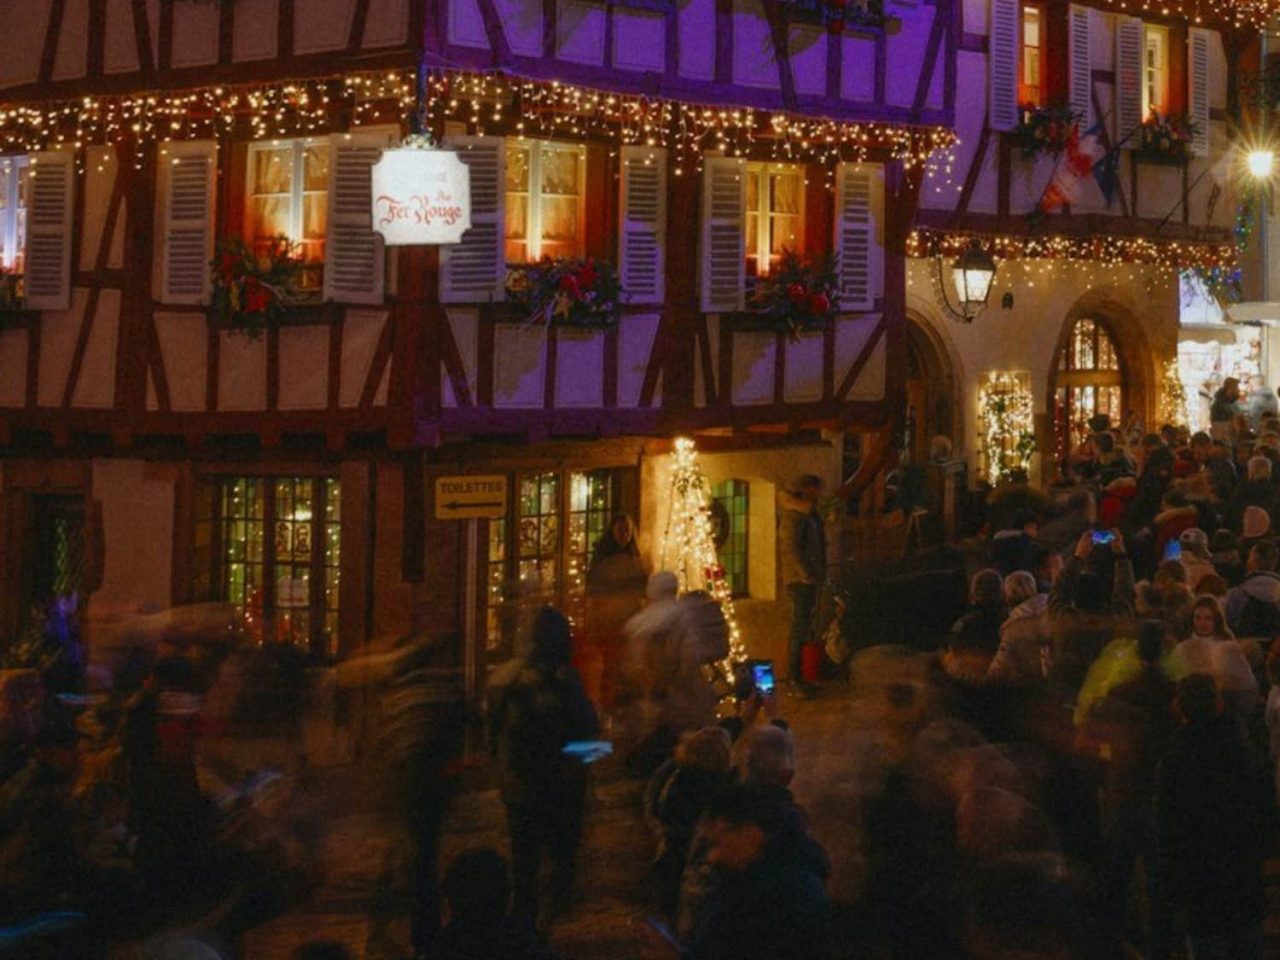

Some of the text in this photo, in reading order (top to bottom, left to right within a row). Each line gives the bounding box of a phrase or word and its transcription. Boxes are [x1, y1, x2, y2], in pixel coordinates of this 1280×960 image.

[376, 193, 462, 226] Fer Rouge
[440, 481, 503, 494] TOILETTES
